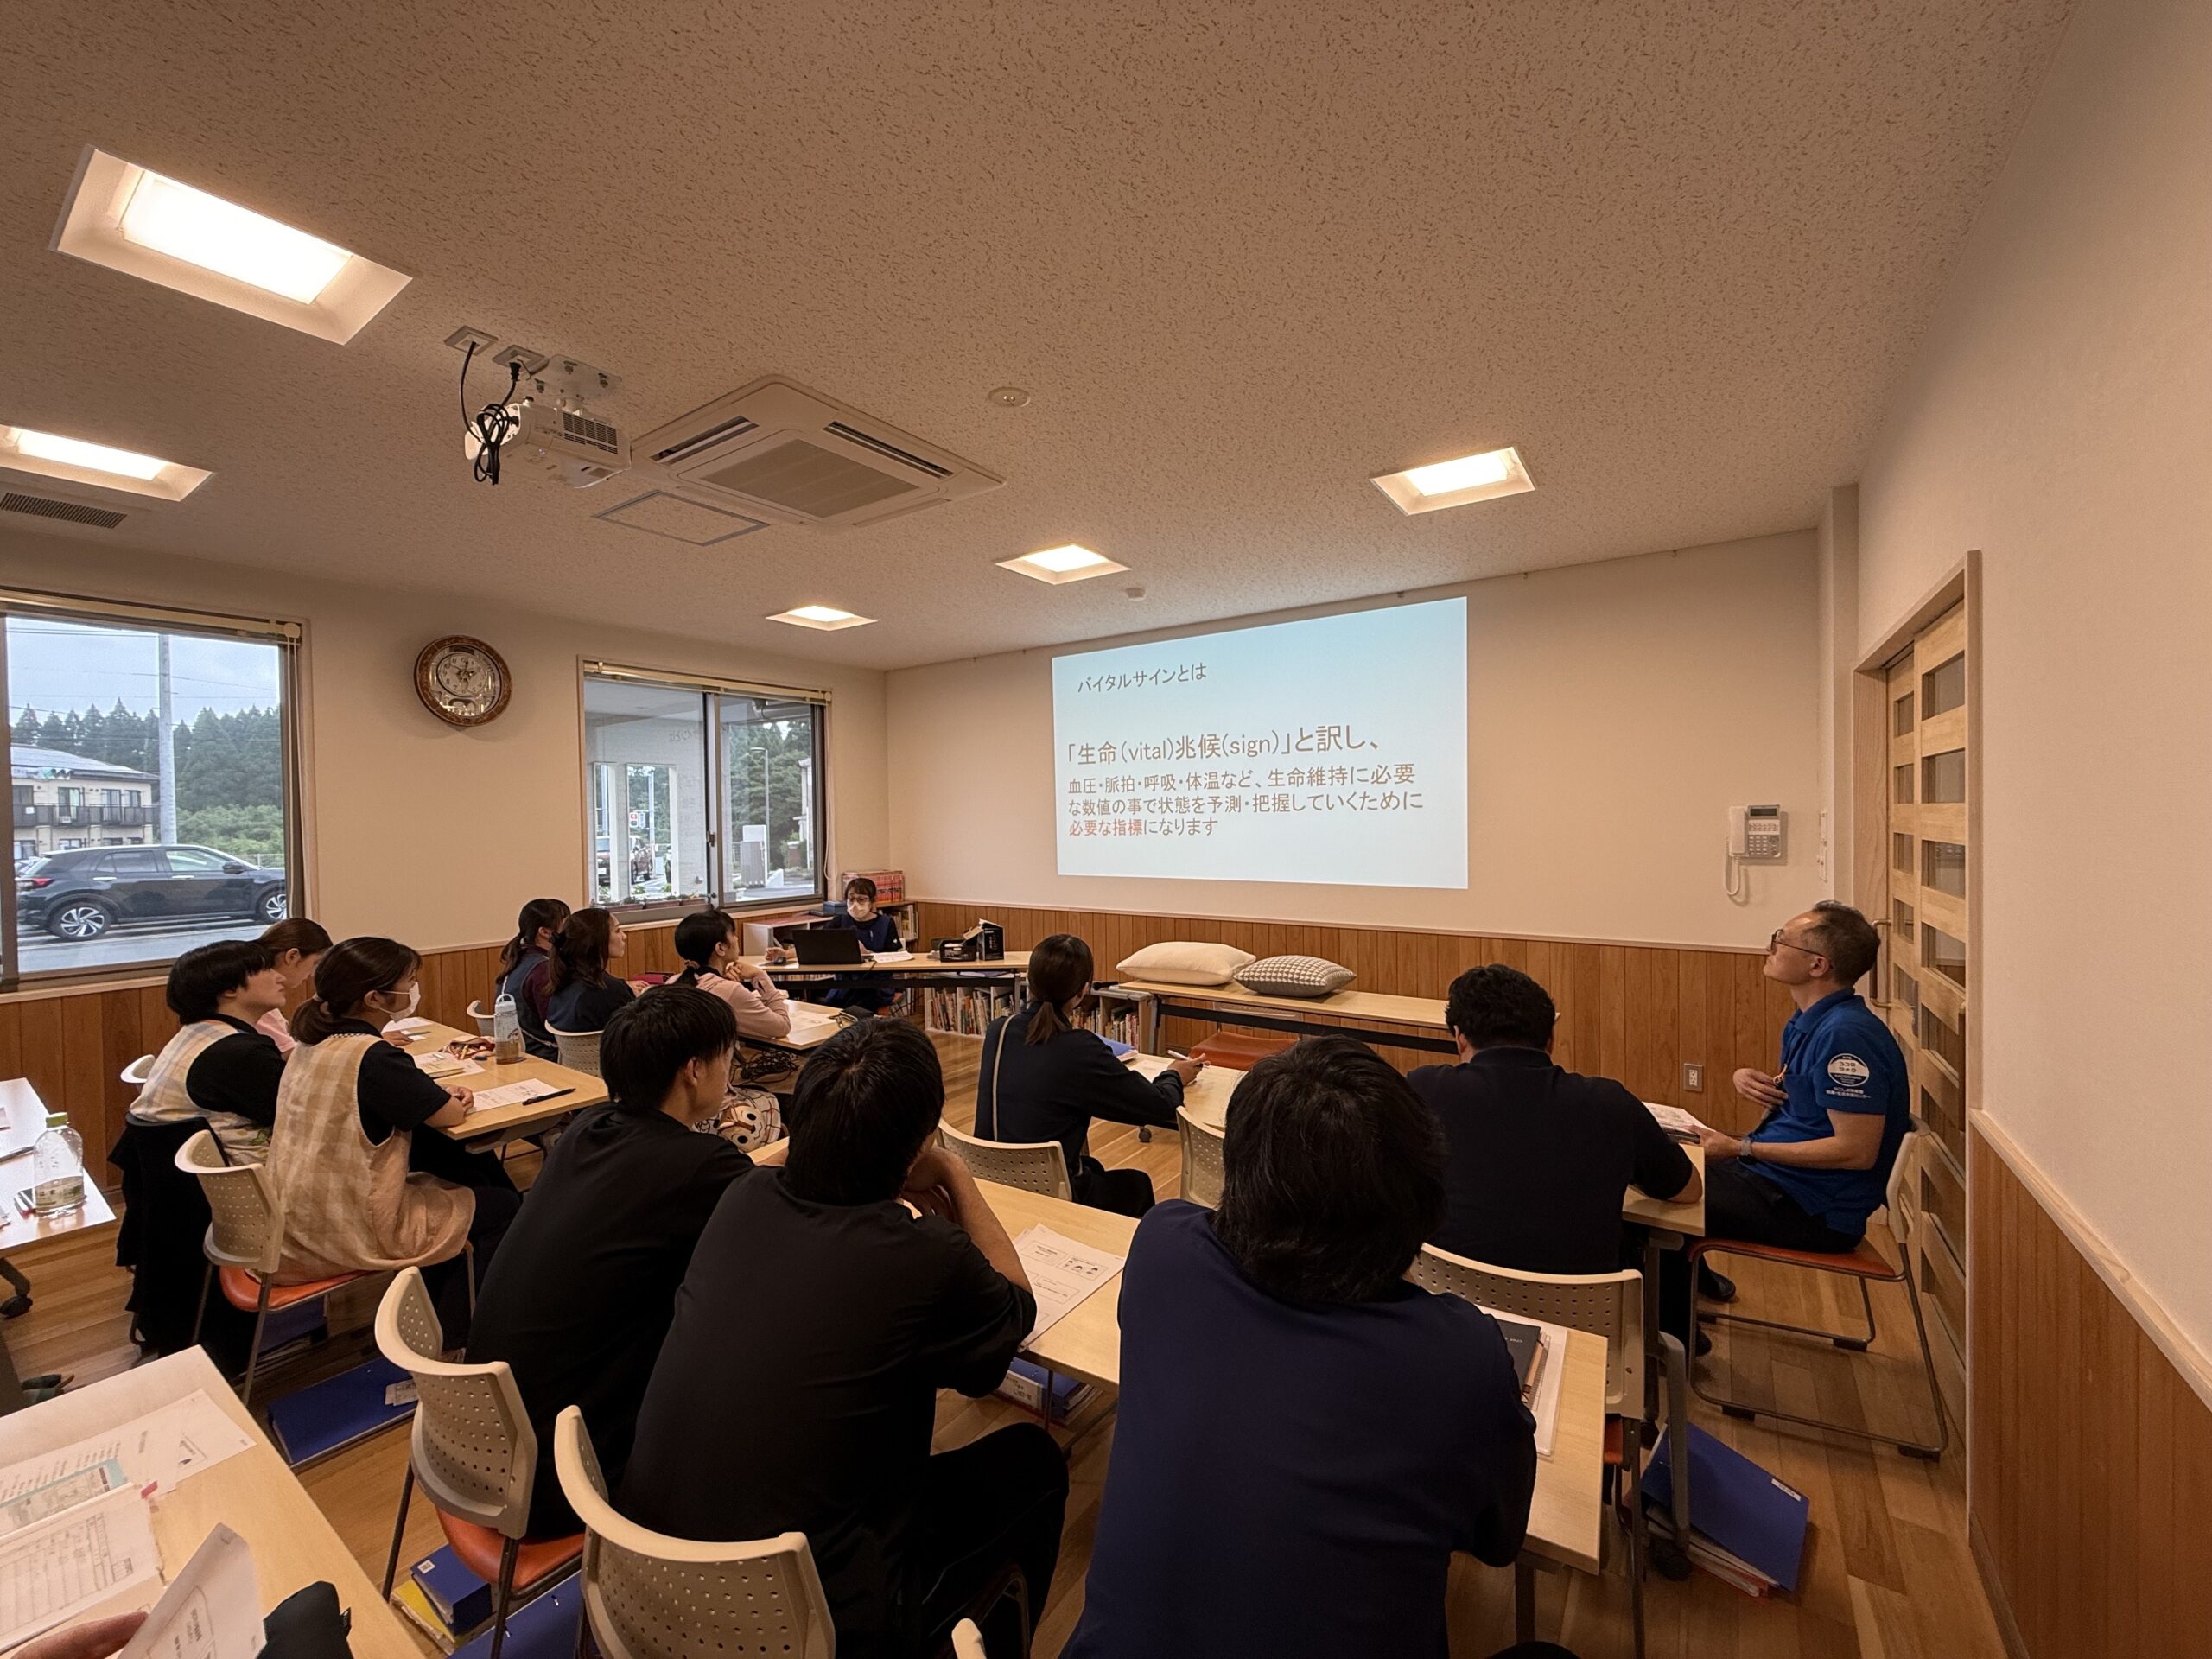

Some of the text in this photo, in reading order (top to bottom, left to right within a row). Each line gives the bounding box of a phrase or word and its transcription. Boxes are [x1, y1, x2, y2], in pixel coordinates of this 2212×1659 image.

[1077, 662, 1207, 692] バイタルサインとは
[1069, 817, 1218, 836] 必要な指標になります
